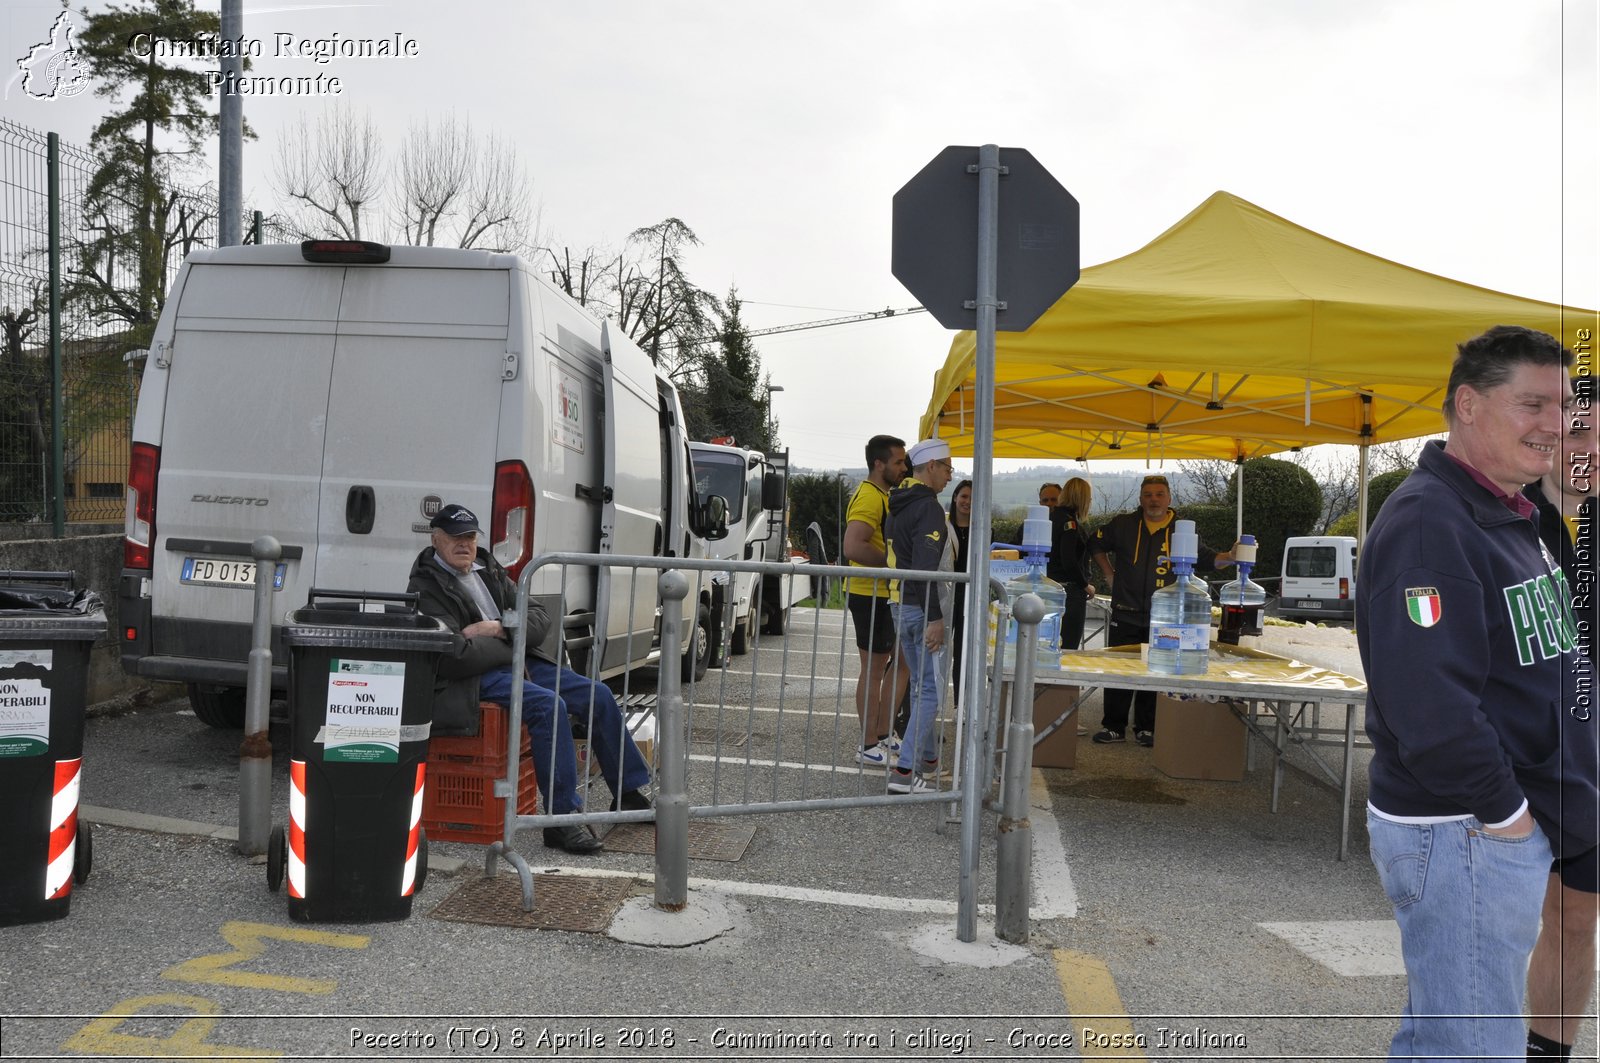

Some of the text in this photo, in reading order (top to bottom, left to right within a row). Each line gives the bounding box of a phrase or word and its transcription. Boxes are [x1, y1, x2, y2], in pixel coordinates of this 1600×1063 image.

[191, 494, 269, 507] DUCATO
[425, 501, 440, 513] FIAT
[193, 561, 215, 580] FD
[1411, 588, 1435, 597] ITALIA
[355, 693, 376, 703] NON
[329, 704, 399, 716] RECUPERABILI
